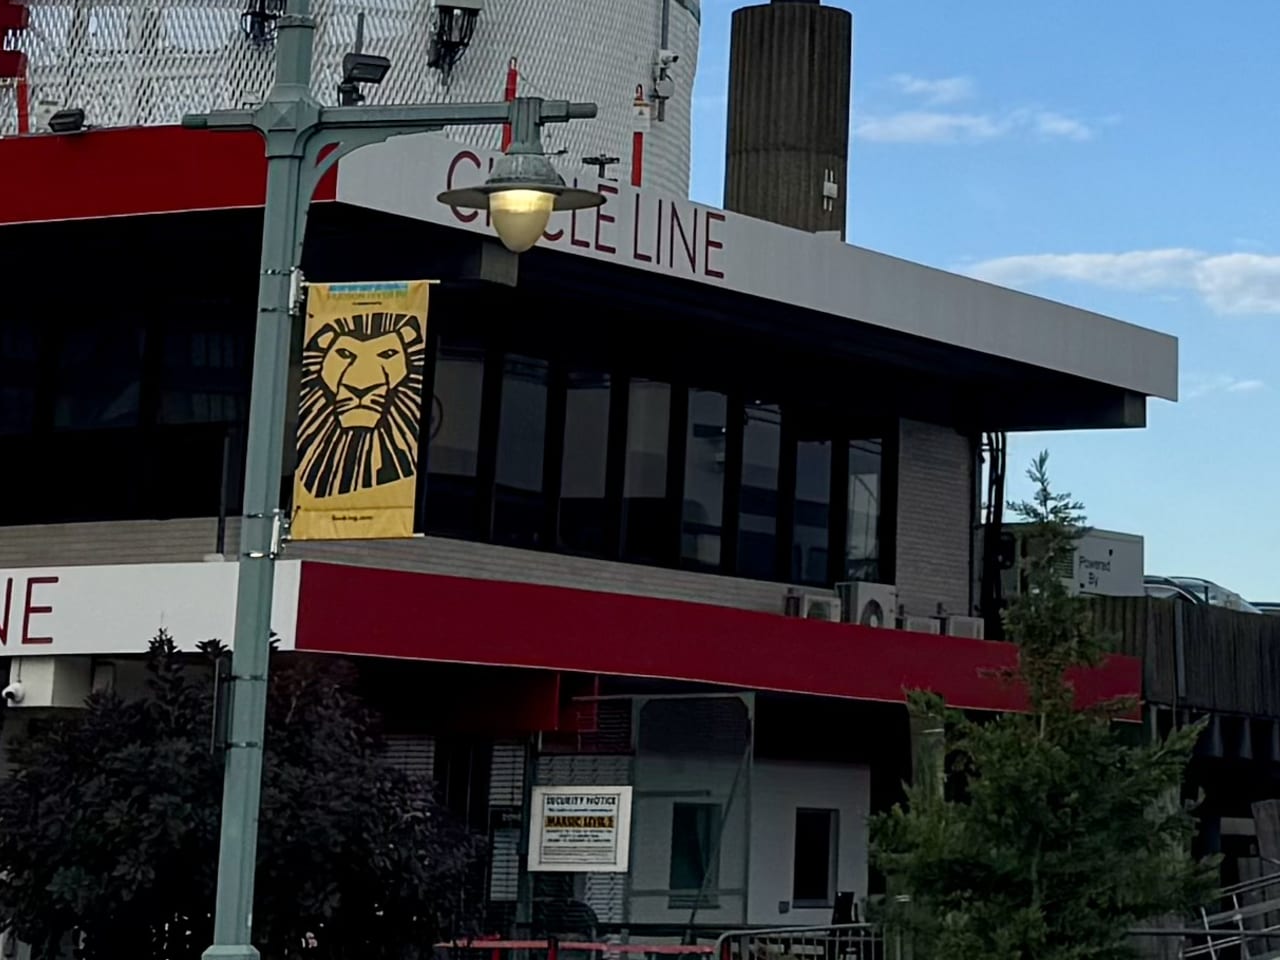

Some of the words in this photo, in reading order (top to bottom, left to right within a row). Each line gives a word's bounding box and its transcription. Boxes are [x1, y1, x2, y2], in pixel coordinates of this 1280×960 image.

[633, 193, 727, 279] LINE
[546, 796, 584, 806] SECURITY
[586, 796, 617, 806] NOTICE
